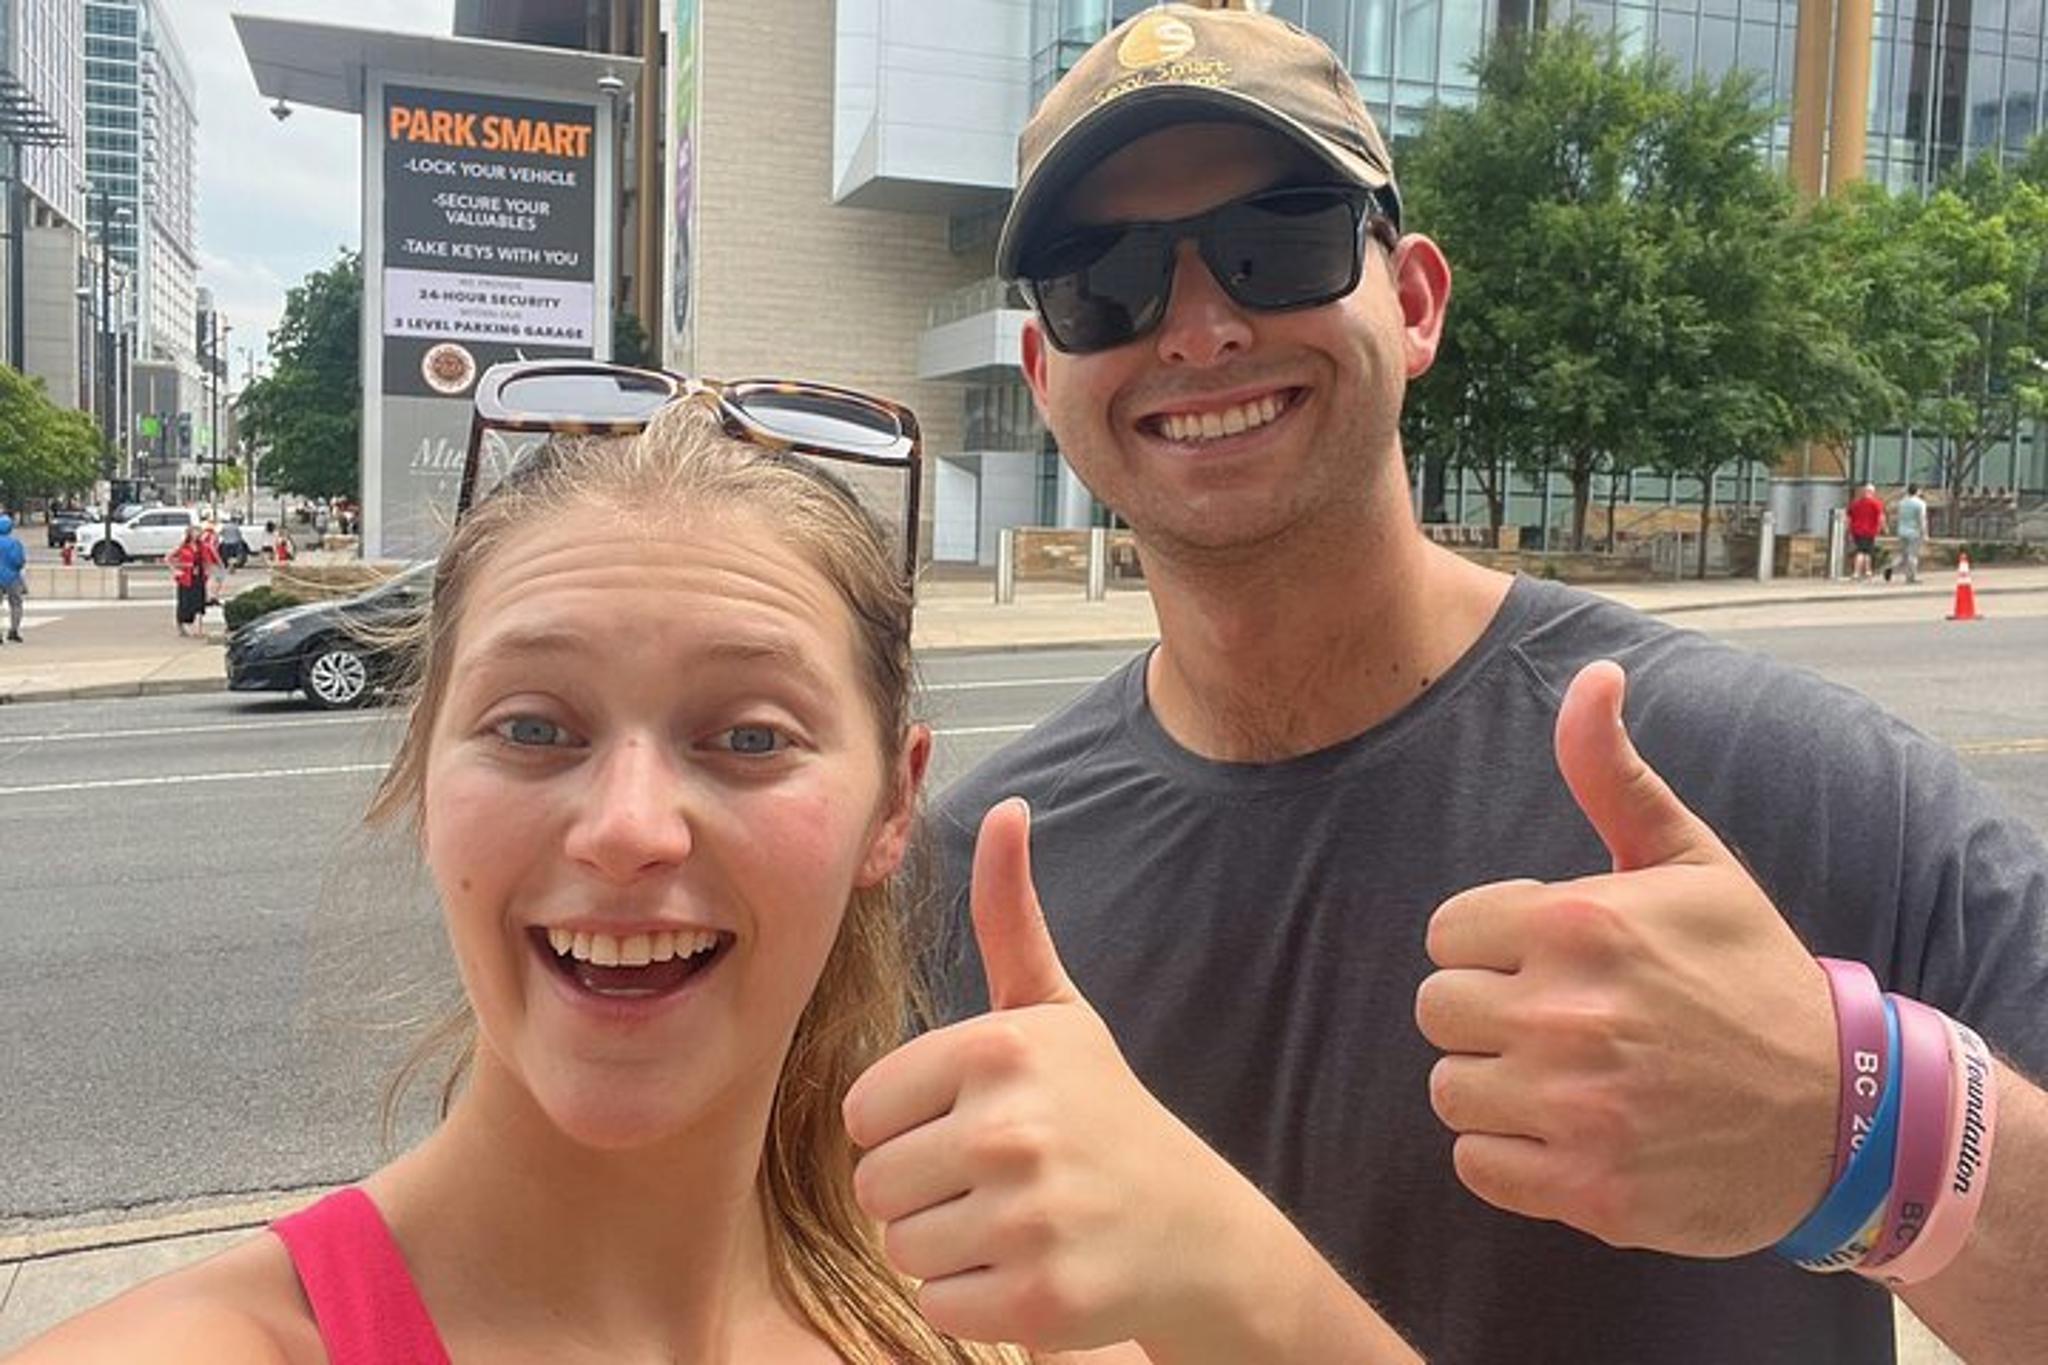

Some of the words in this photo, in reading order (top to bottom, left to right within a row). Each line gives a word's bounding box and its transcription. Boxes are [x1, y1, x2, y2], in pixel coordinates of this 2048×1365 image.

[389, 106, 477, 147] PARK
[481, 115, 592, 158] SMART
[404, 158, 456, 175] -LOCK
[460, 162, 506, 181] YOUR
[510, 167, 577, 187] VEHICLE
[433, 192, 501, 212] -SECURE
[506, 198, 550, 216] YOUR
[445, 210, 537, 231] VALUABLES
[403, 238, 447, 257] -TAKE
[451, 242, 493, 261] KEYS
[497, 247, 541, 265] WITH
[544, 250, 579, 266] YOU
[419, 289, 487, 304] 24-HOUR
[491, 293, 561, 308] SECURITY
[407, 318, 450, 331] LEVEL
[453, 320, 521, 336] PARKING
[524, 326, 585, 340] GARAGE
[1854, 1050, 1879, 1097] BC
